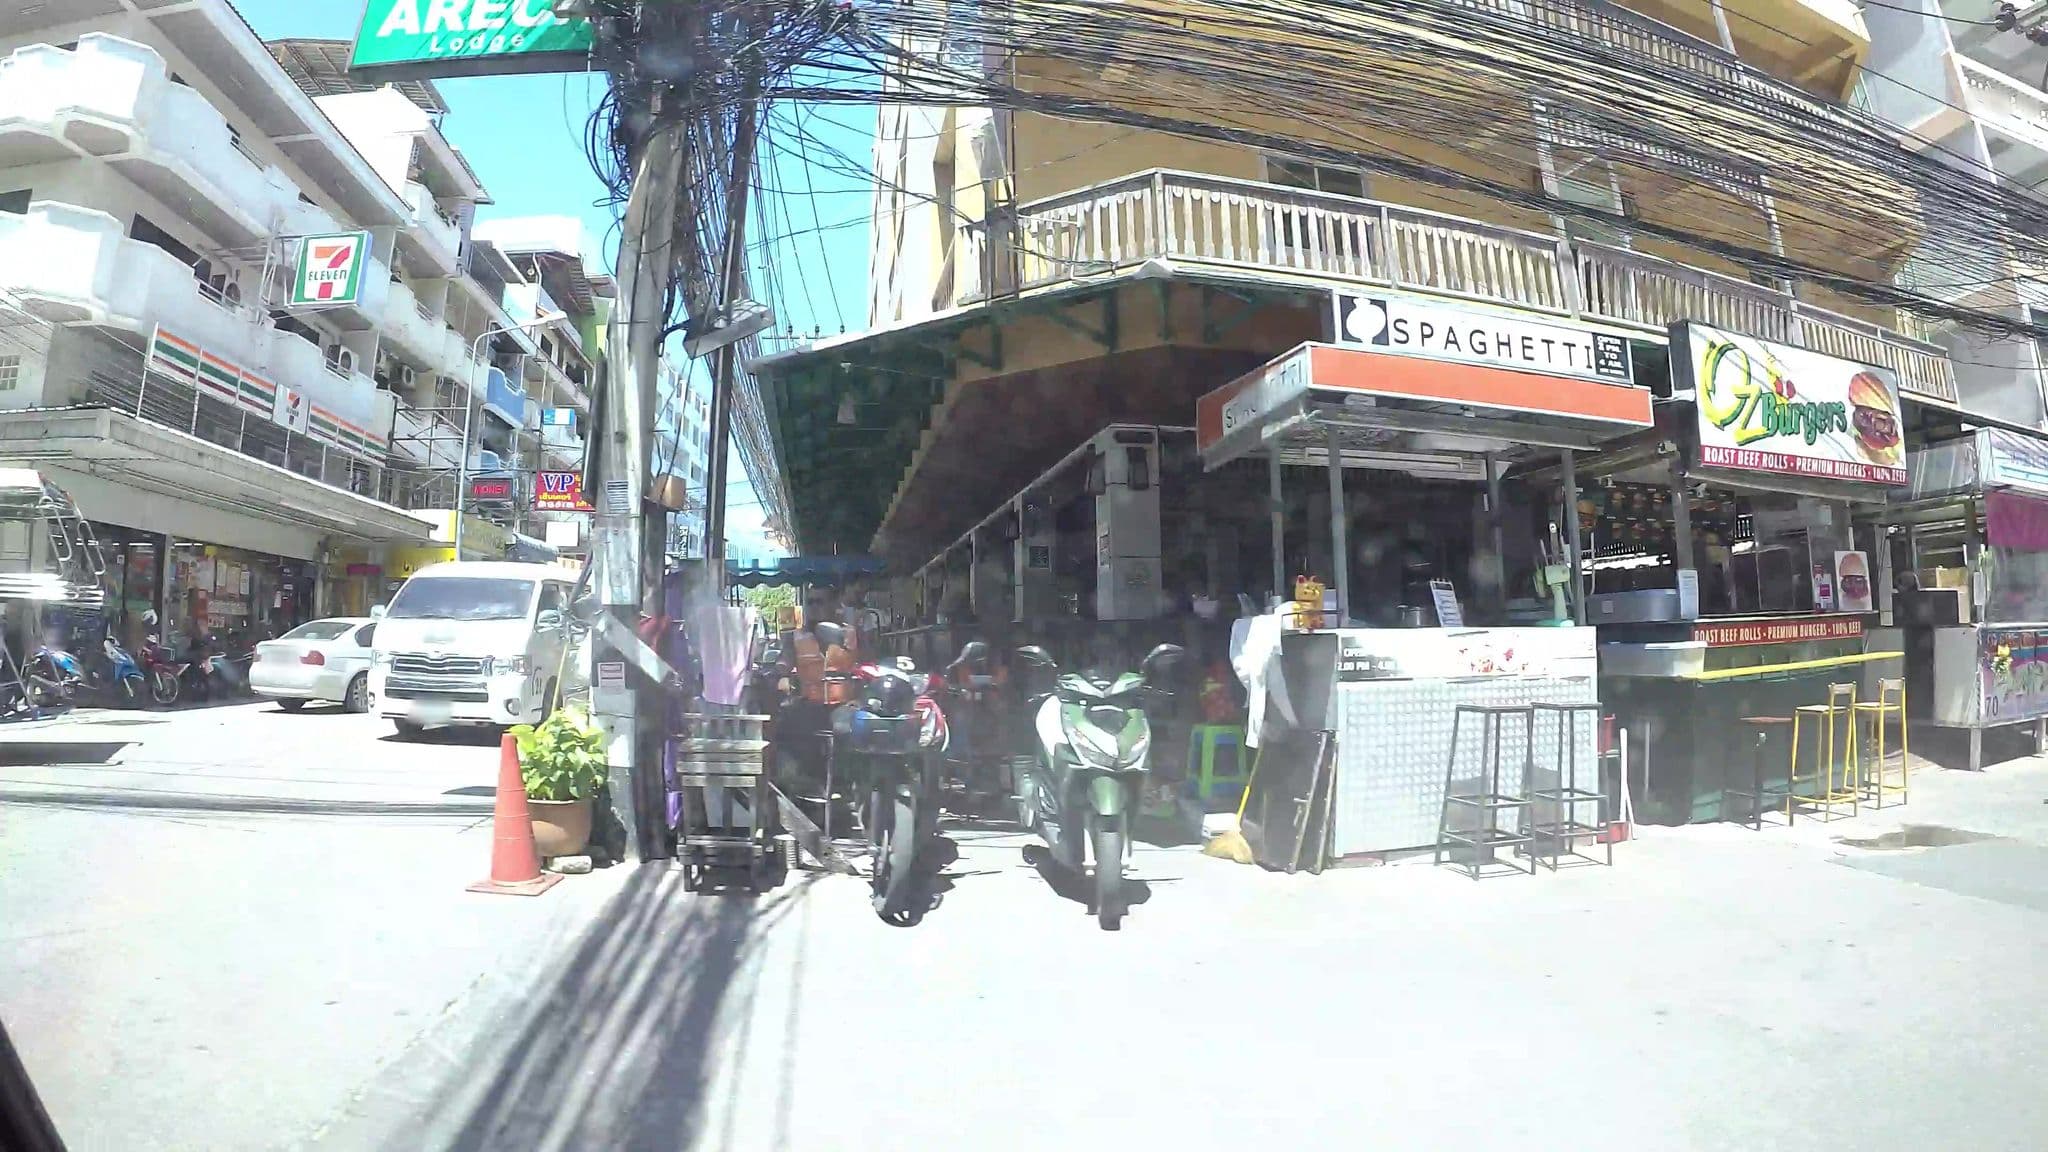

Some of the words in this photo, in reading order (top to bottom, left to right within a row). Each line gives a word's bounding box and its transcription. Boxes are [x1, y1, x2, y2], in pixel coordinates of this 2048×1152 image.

[430, 34, 525, 52] Lodge
[1393, 318, 1593, 369] SPAGHETTI
[1604, 352, 1618, 360] TO
[1761, 393, 1848, 446] Burgers
[1704, 446, 1735, 464] ROAST
[1737, 450, 1760, 467] BEEF
[1762, 454, 1788, 470] ROLLS
[1796, 457, 1833, 474] PREMIUM
[1834, 461, 1867, 478] BURGERS
[1873, 466, 1891, 481] 100%
[1892, 468, 1907, 483] BEEF
[541, 472, 575, 493] VP
[1694, 630, 1718, 643] ROAST
[1720, 628, 1738, 643] BEEF
[1739, 627, 1761, 641] ROLLS
[1768, 624, 1798, 640] PREMIUM
[1800, 623, 1827, 638] BURGERS
[1832, 622, 1847, 636] 100%
[1849, 621, 1861, 634] BEEF
